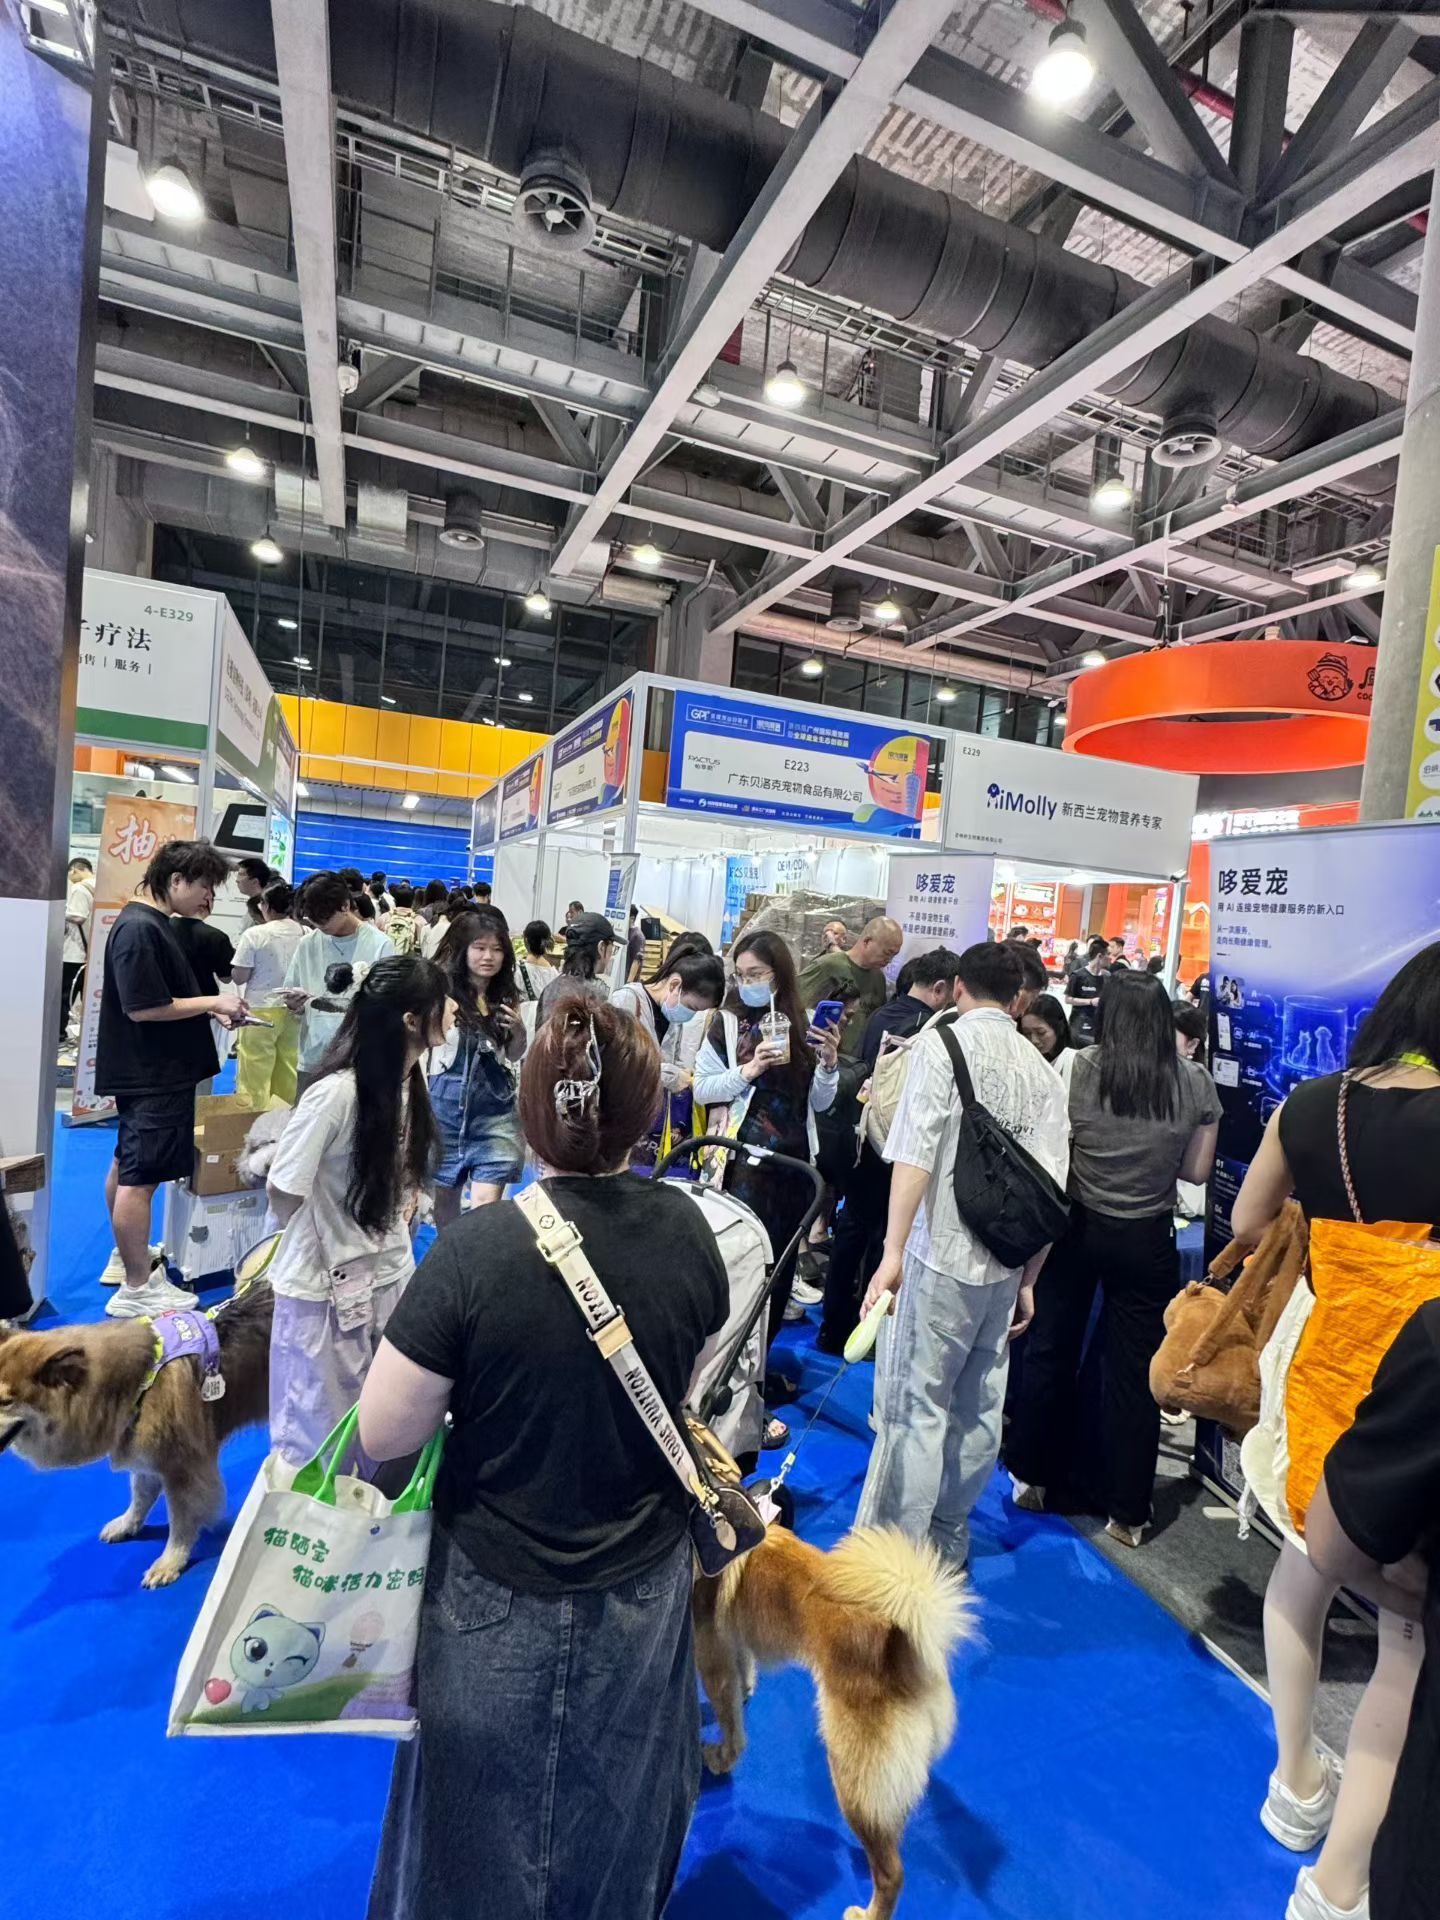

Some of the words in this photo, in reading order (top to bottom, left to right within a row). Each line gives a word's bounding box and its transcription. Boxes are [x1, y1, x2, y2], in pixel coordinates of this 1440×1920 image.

[144, 605, 194, 622] 4-E329
[784, 759, 810, 773] E223
[962, 746, 981, 758] E229
[727, 772, 863, 804] 广东贝洛克宠物食品有限公司
[1062, 801, 1163, 831] 新西兰宠物营养专家
[916, 873, 956, 894] 哆爱宠
[1218, 867, 1289, 896] 哆爱宠
[624, 1366, 664, 1428] VUITTON
[659, 1423, 685, 1466] LOUIS
